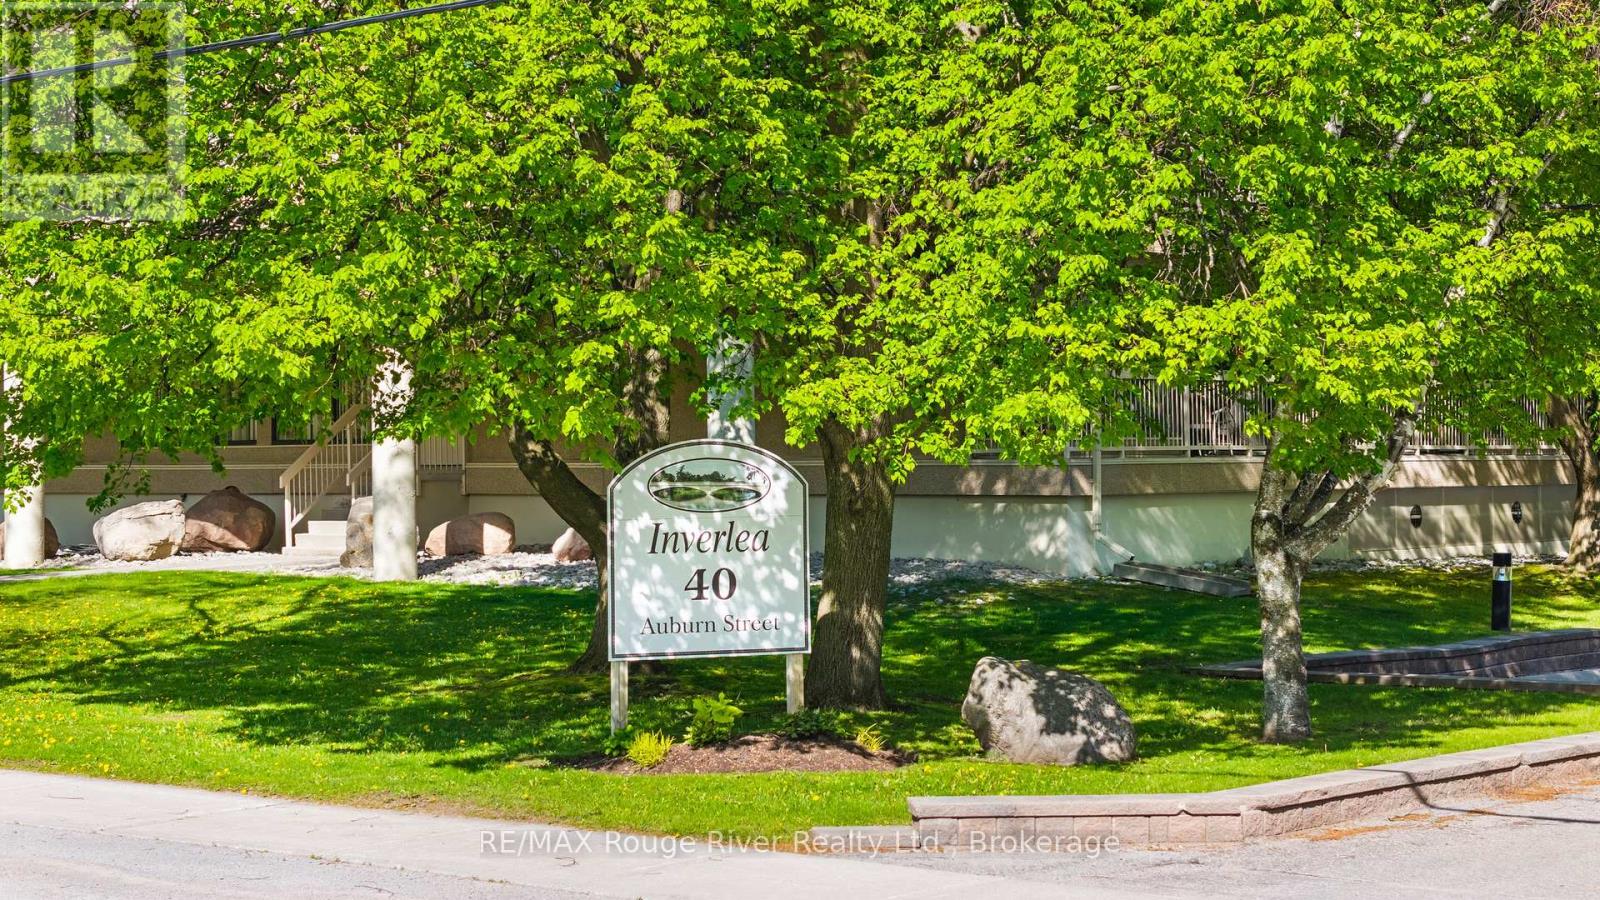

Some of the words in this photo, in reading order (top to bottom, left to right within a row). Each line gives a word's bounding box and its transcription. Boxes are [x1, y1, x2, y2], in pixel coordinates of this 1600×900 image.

[648, 521, 770, 555] Inverlea
[684, 567, 737, 601] 40
[640, 616, 716, 635] Auburn
[723, 614, 780, 633] Street
